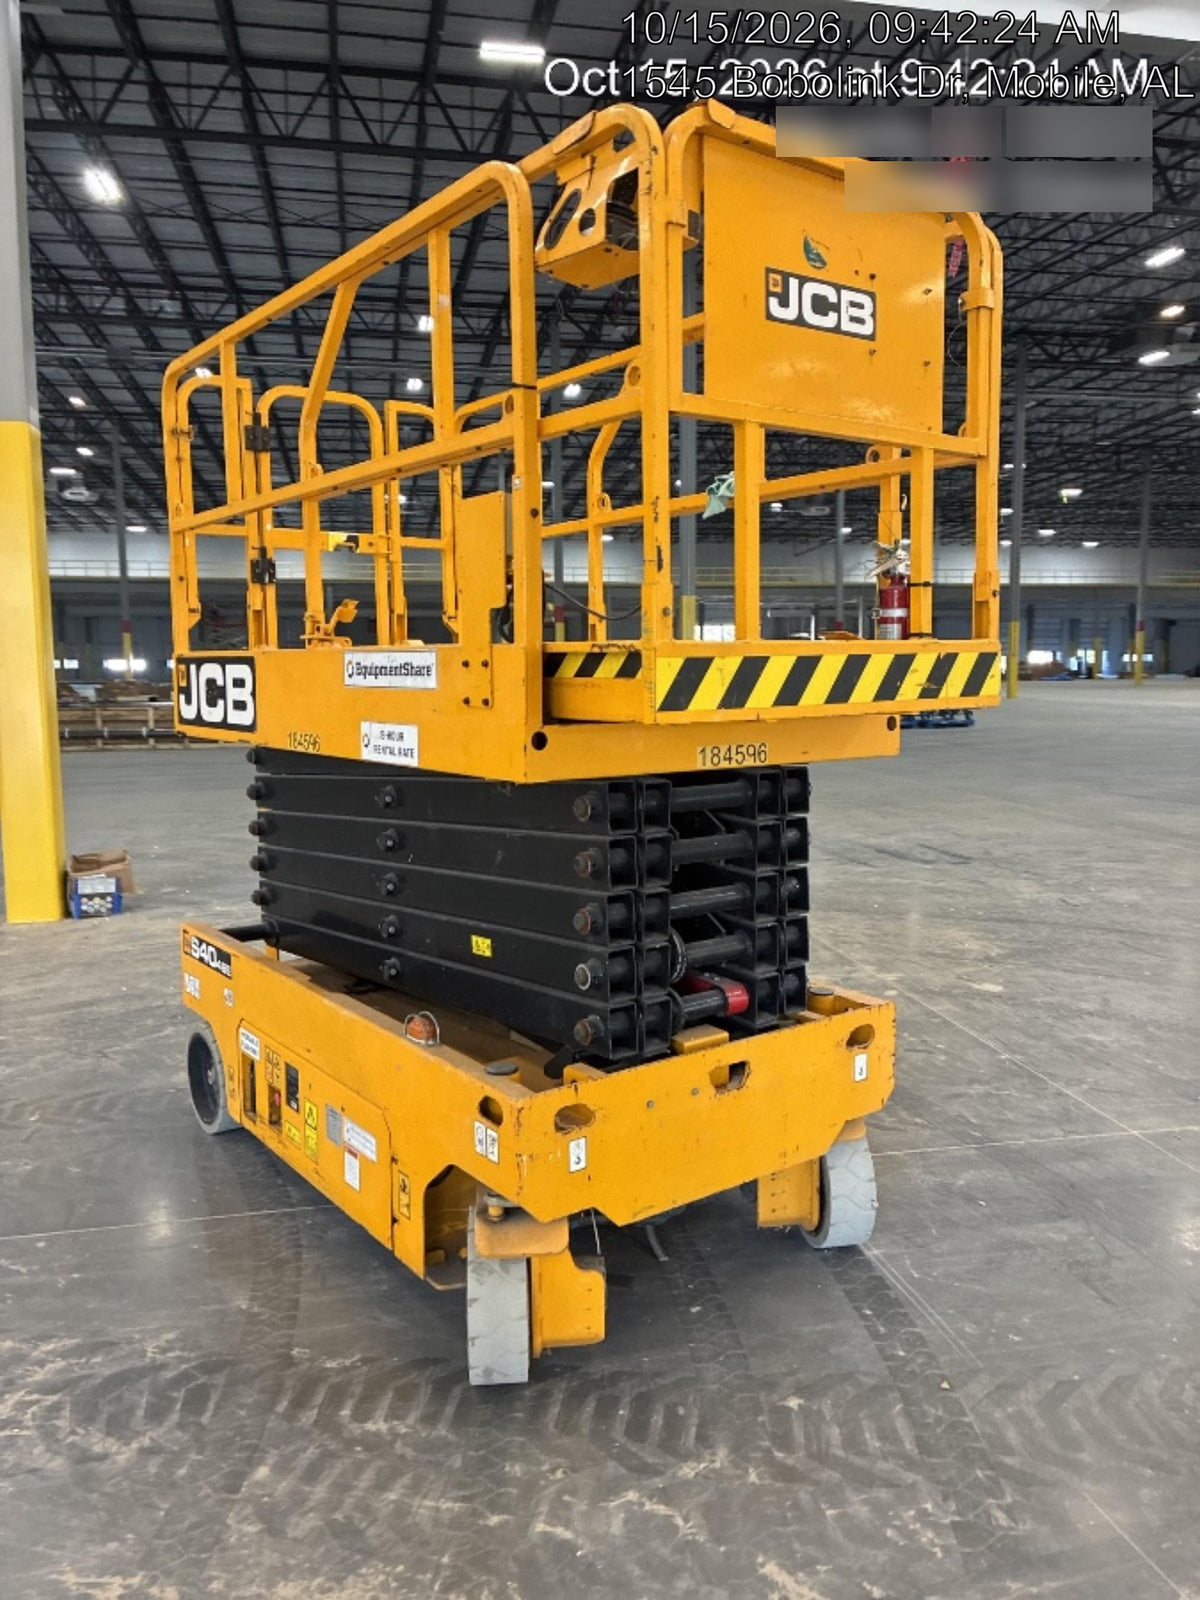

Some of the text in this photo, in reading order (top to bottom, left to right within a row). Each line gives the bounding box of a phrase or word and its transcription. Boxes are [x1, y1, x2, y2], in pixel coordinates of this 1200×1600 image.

[768, 276, 875, 335] JCB
[355, 662, 433, 680] EquipmentShare
[178, 662, 256, 726] JCB
[698, 742, 767, 767] 184596
